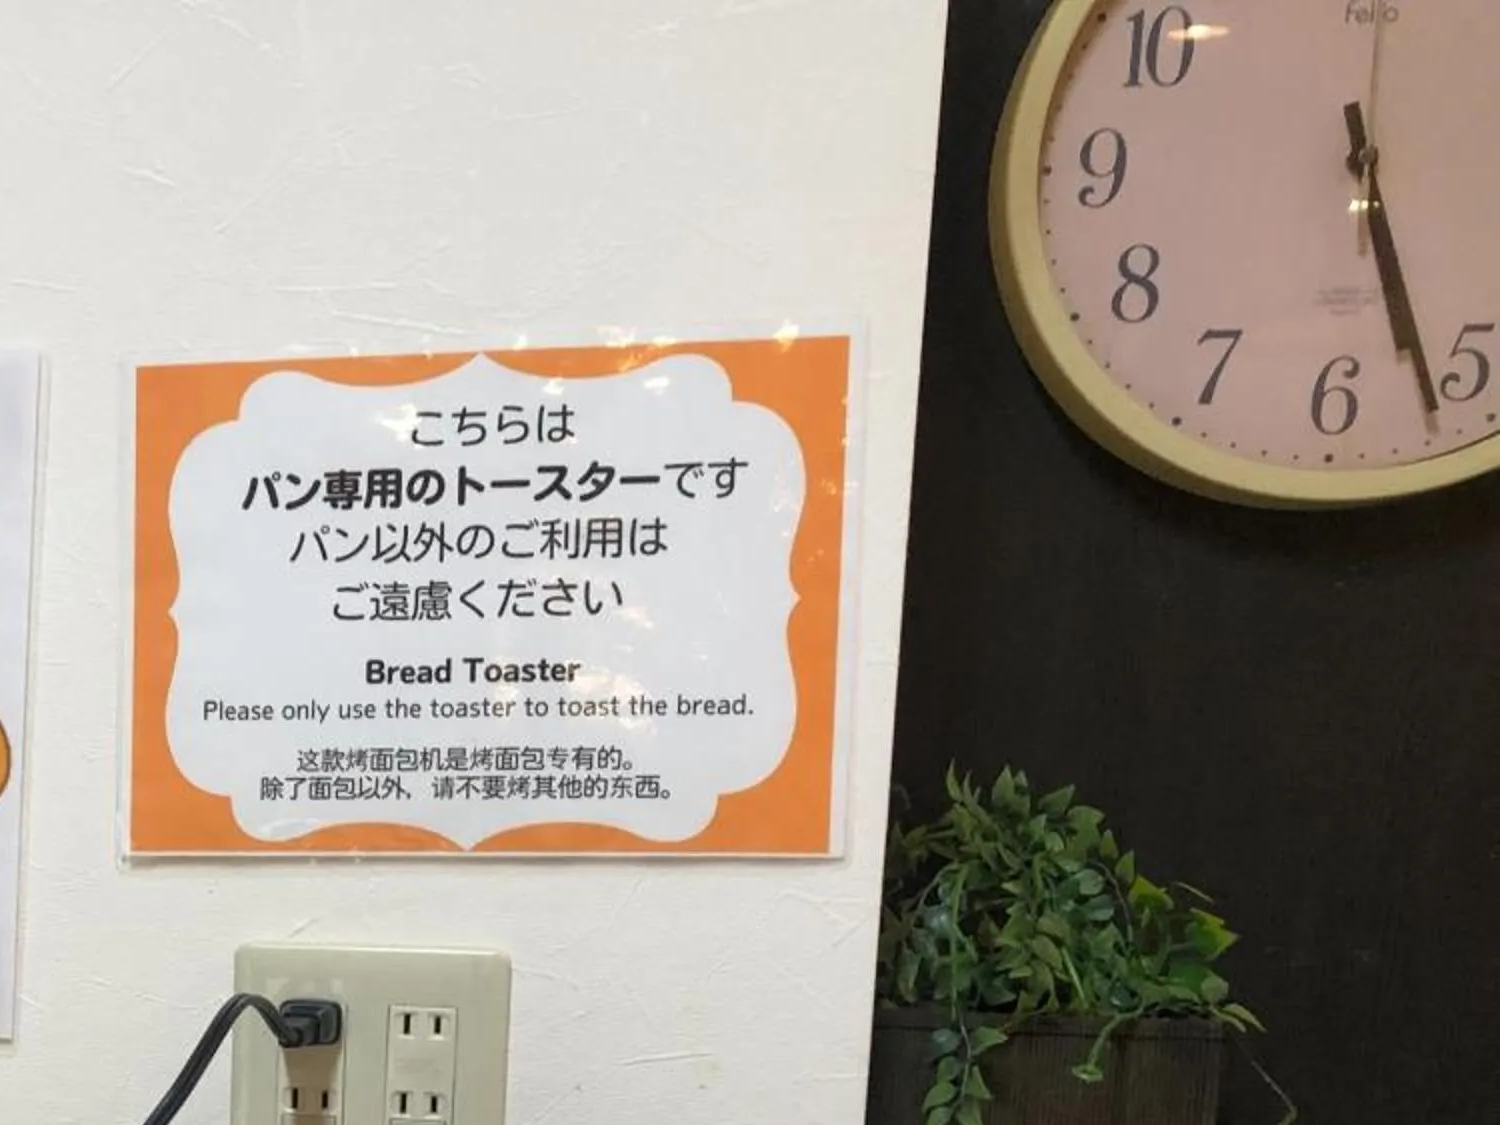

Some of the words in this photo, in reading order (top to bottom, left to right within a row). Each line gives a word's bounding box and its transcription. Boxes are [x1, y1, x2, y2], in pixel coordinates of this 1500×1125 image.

[1122, 6, 1195, 88] 10
[1078, 127, 1127, 208] 9
[1111, 244, 1160, 323] 8
[1197, 329, 1243, 405] 7
[1440, 323, 1495, 401] 5
[1311, 356, 1361, 435] 6
[411, 404, 576, 447] こちらは
[242, 456, 750, 510] パン専用のトースターです
[290, 516, 669, 564] パン以外のご利用は
[333, 578, 624, 622] ご遠慮ください
[366, 658, 452, 685] Bread
[463, 657, 581, 683] Toaster
[203, 698, 274, 722] Please
[281, 699, 330, 724] only
[338, 701, 376, 719] use
[385, 697, 422, 719] the
[429, 698, 516, 719] toaster
[524, 697, 549, 717] to
[558, 696, 620, 717] toast
[628, 694, 668, 717] the
[676, 693, 756, 717] bread.
[296, 747, 633, 773] 这款烤面包机是烤面包专有的。
